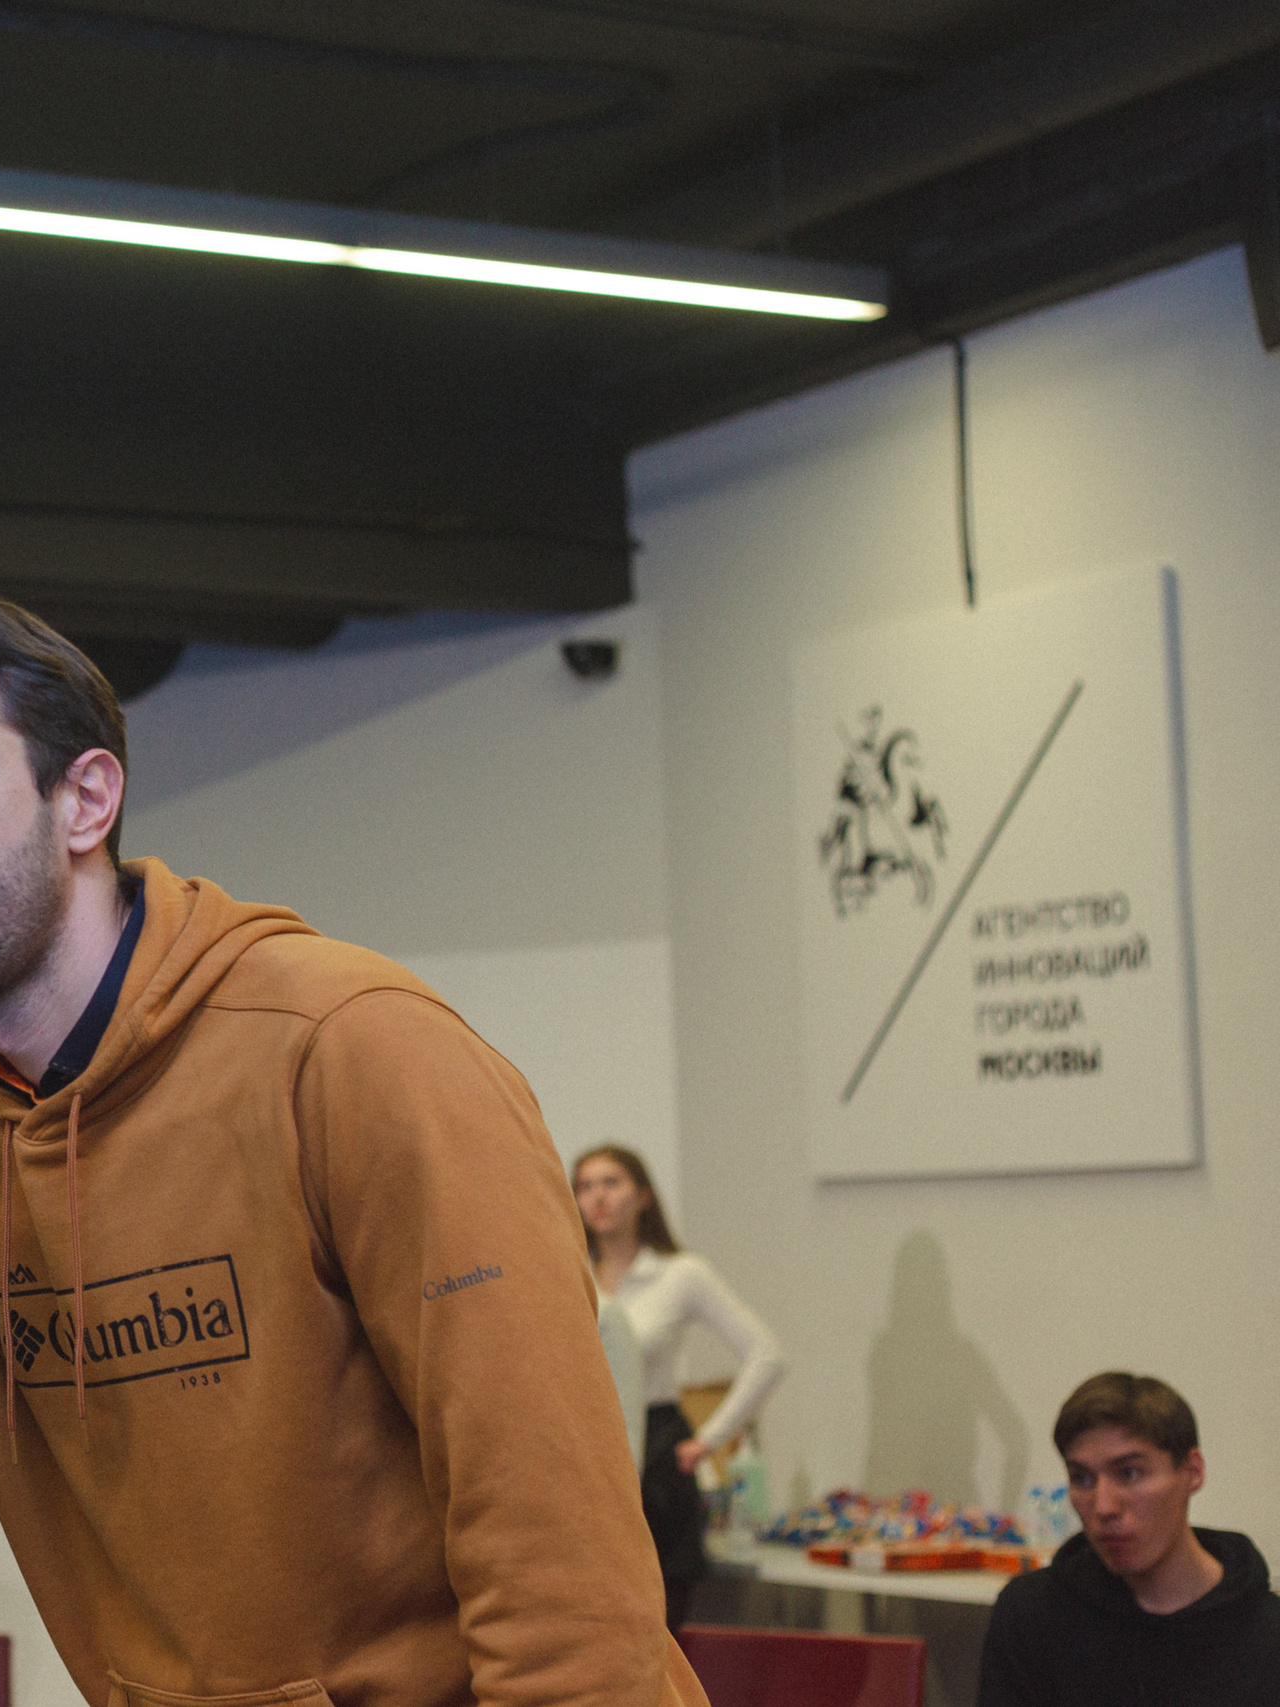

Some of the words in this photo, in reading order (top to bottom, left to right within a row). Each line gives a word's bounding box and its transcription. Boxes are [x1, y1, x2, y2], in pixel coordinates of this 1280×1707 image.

[973, 892, 1131, 938] АГЕНТСТВО
[975, 933, 1150, 984] ИННОВАЦИЙ
[975, 997, 1084, 1034] ГОРОДА
[979, 1045, 1101, 1080] МОСКВЫ
[423, 1263, 504, 1300] Columbia
[48, 1287, 234, 1365] Cumbia
[181, 1371, 221, 1390] 1938
